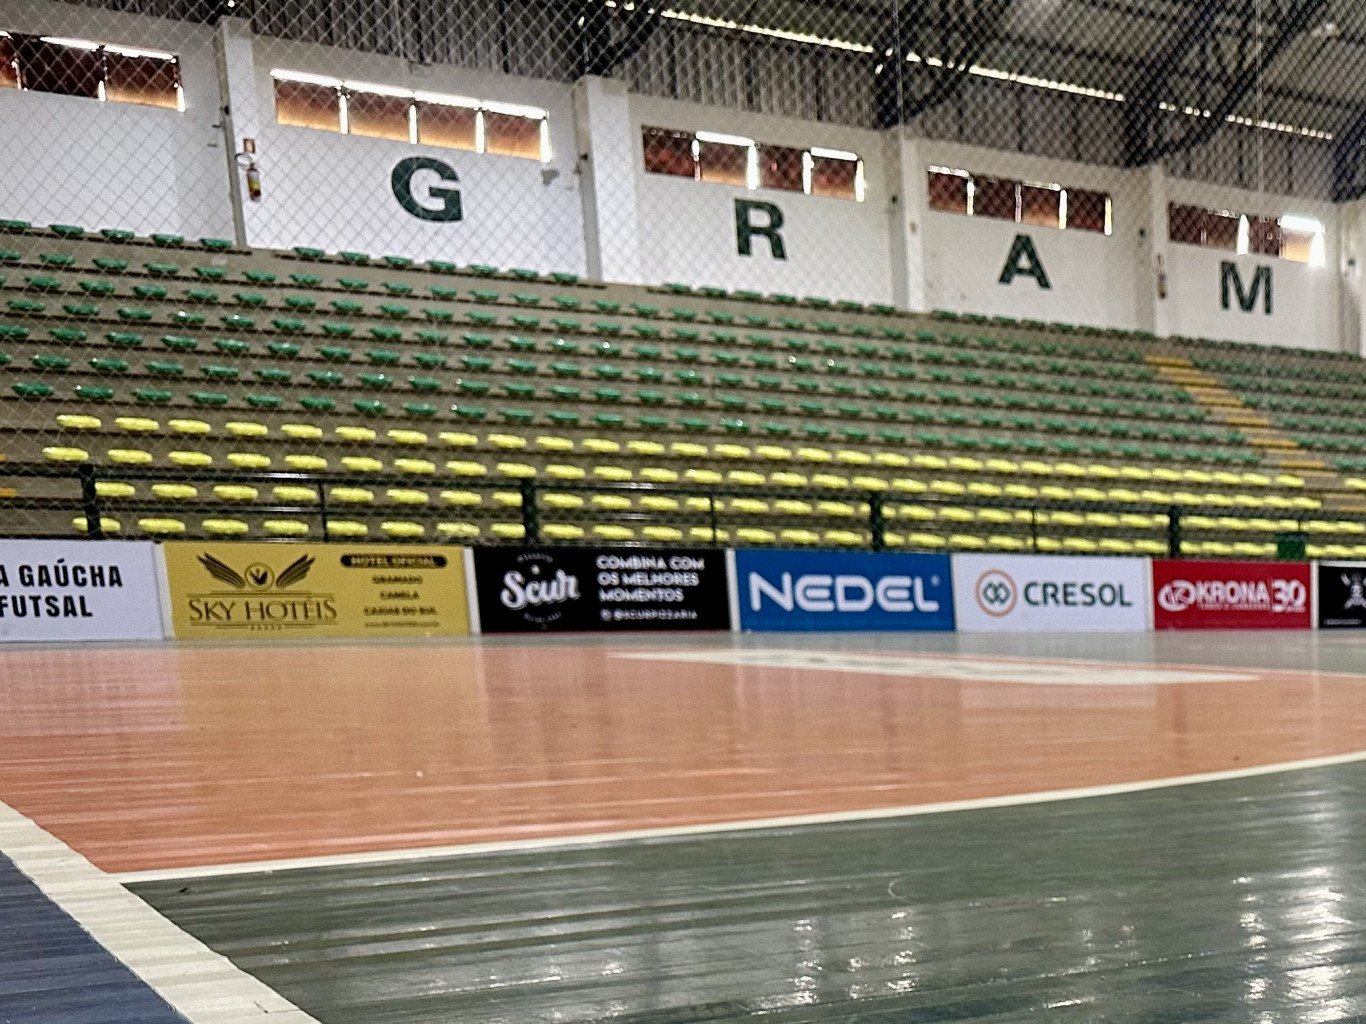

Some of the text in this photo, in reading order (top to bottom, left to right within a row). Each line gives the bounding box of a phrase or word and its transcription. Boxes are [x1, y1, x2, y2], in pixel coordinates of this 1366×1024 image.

[19, 558, 123, 587] GAÚCHA
[597, 556, 705, 570] COMBINA COM
[598, 572, 699, 586] OS MELHORES
[599, 588, 684, 602] MOMENTOS
[749, 572, 939, 612] NEDEL
[1024, 582, 1132, 607] CRESOL
[1196, 579, 1307, 613] KRONA 30
[0, 595, 93, 617] FUTSAL
[189, 598, 236, 622] SKY
